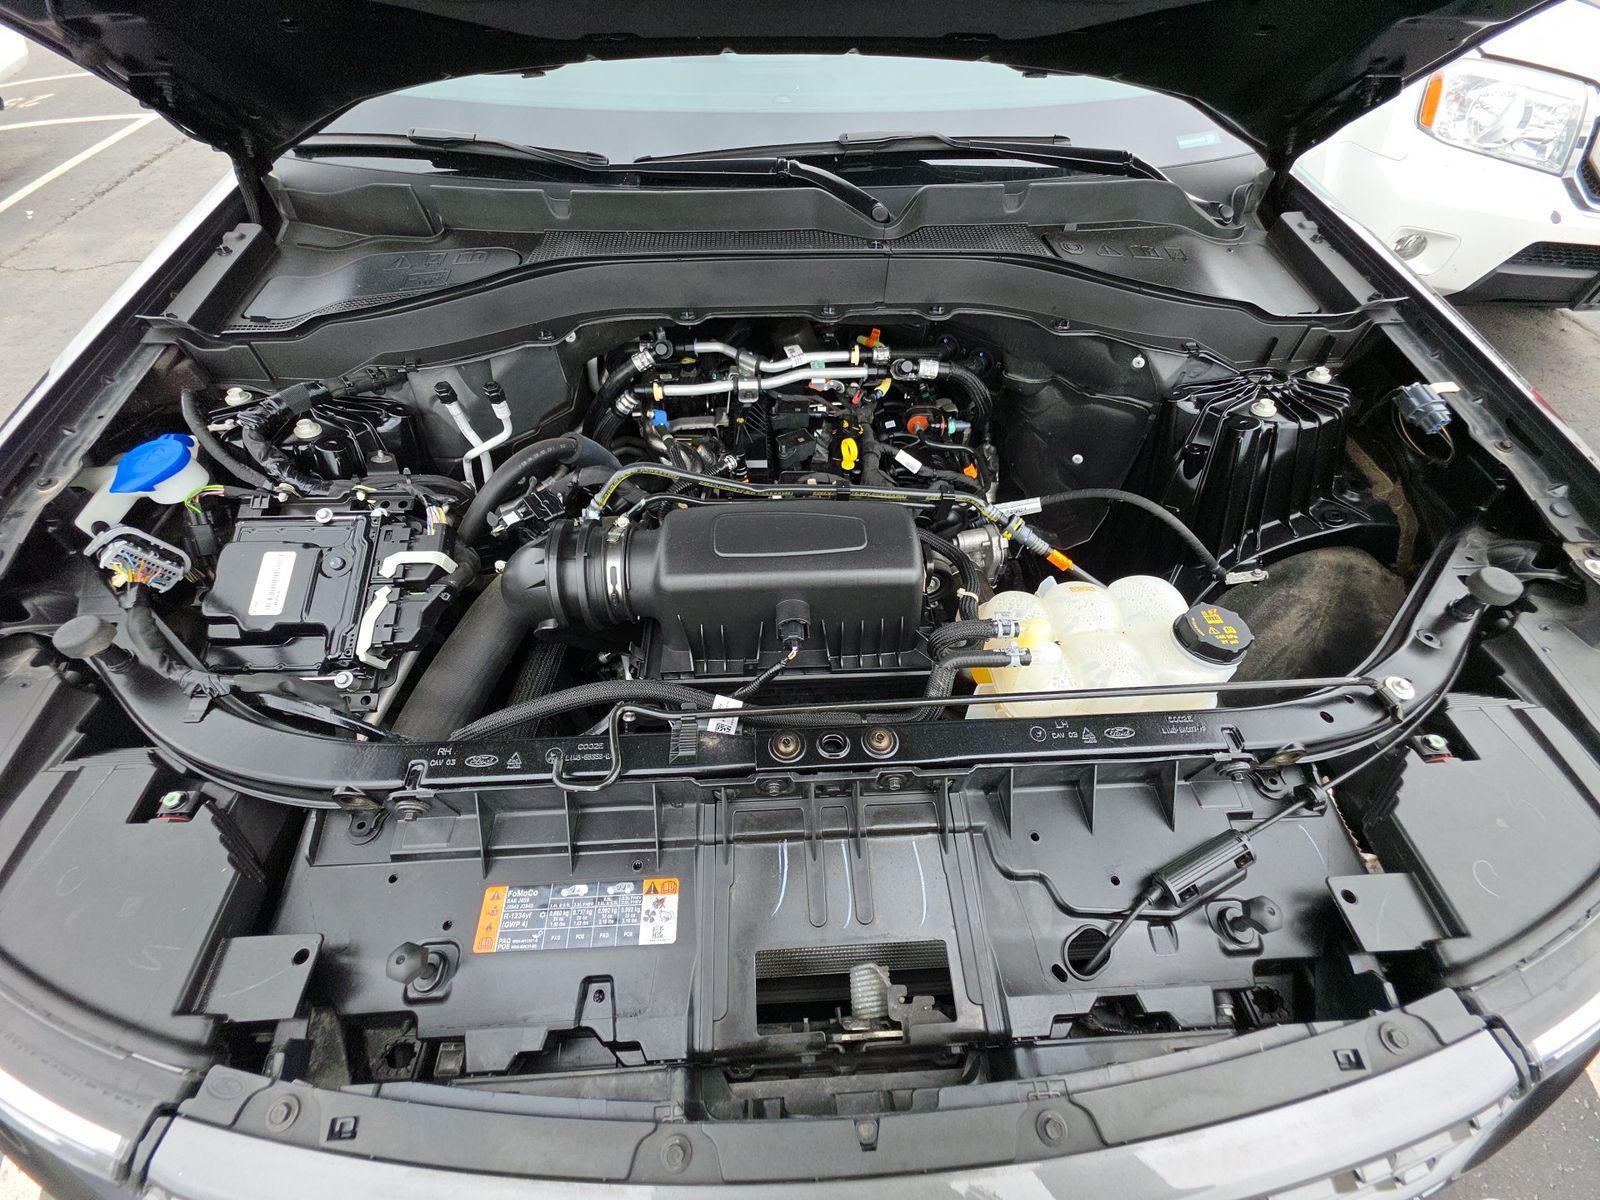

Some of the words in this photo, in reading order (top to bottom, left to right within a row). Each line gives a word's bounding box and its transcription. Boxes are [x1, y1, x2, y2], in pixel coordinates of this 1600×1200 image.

[1106, 727, 1134, 738] Ford
[437, 747, 453, 756] RH
[508, 889, 538, 898] FoMoCo
[504, 912, 533, 920] R-1234yf
